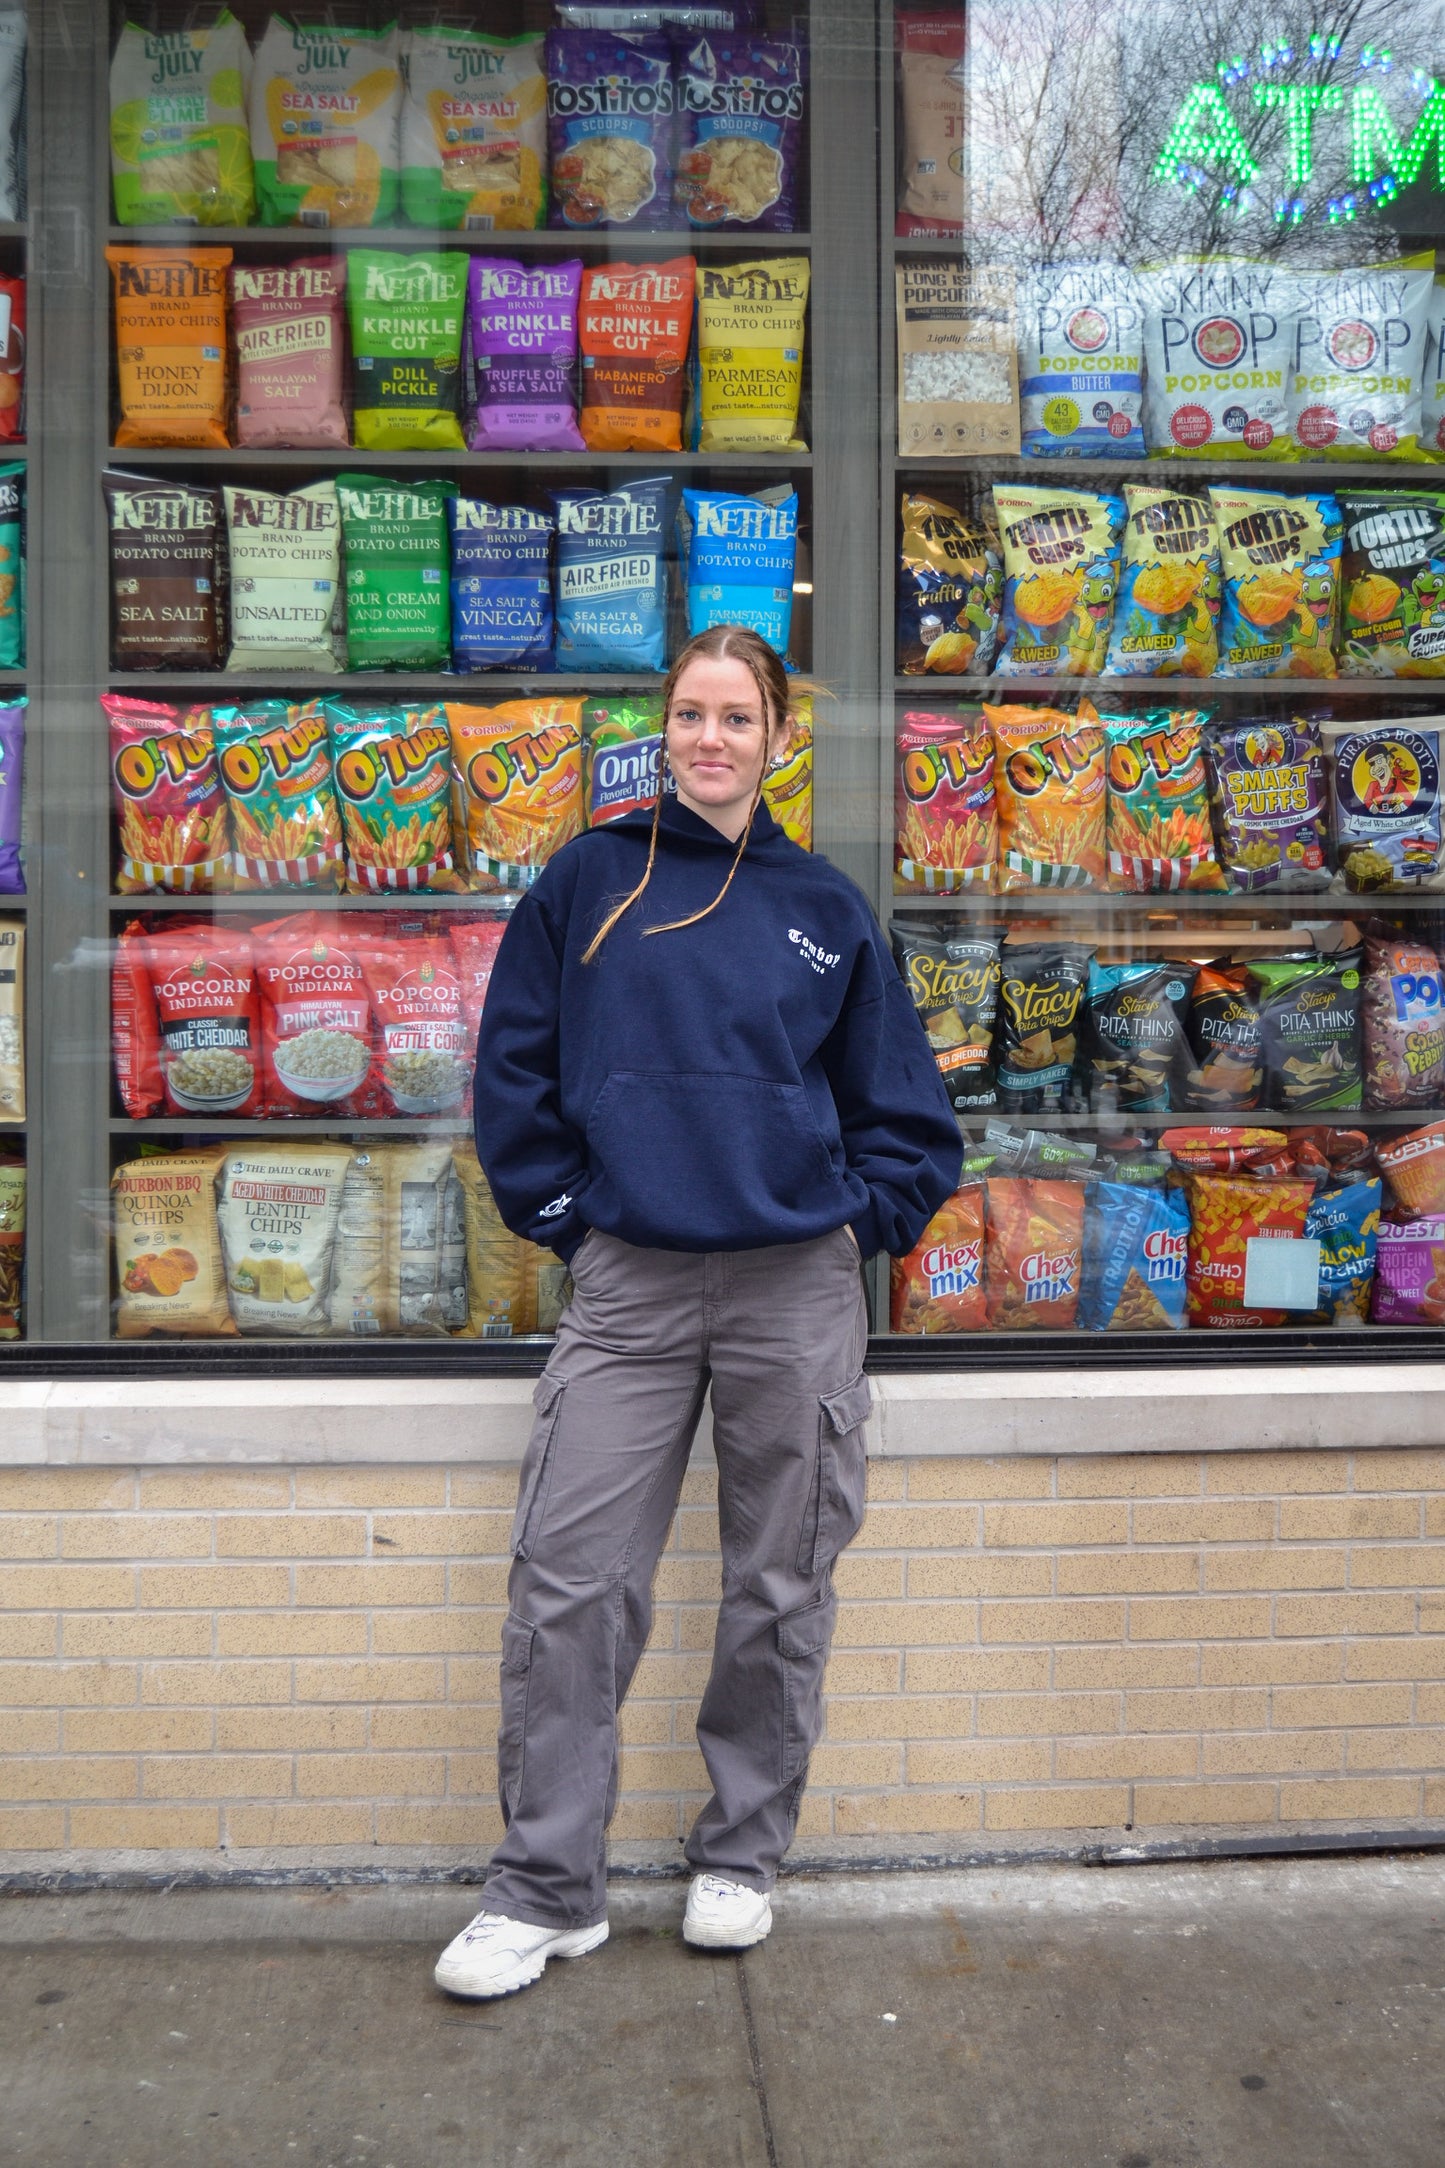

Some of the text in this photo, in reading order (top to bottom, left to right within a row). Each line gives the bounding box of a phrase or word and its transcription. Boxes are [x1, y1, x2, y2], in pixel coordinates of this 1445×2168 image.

[152, 51, 203, 84] JULY
[297, 47, 349, 75] JULY
[455, 54, 505, 84] JULY
[148, 96, 205, 109] SEA SALT
[281, 94, 357, 111] SEA SALT
[442, 102, 516, 116] SEA SALT
[1154, 83, 1445, 184] ATM
[119, 260, 222, 297] KETTLE
[234, 268, 337, 302] KETTLE
[365, 261, 461, 302] KETTLE
[479, 268, 574, 301] KETTLE
[589, 270, 683, 303] KETTLE
[702, 269, 805, 300] KETTLE
[1037, 271, 1132, 302] SKINNY
[1160, 274, 1274, 313] SKINNY
[734, 305, 773, 313] BRAND
[120, 316, 220, 327] POTATO CHIPS
[363, 317, 457, 335] KRINKLE
[481, 315, 572, 332] KRINKLE
[586, 317, 679, 336] KRINKLE
[704, 317, 801, 330] POTATO CHIPS
[1038, 305, 1138, 354] POP
[243, 320, 326, 350] AIR FRIED
[508, 333, 545, 347] CUT
[1162, 313, 1277, 372] POP
[1296, 316, 1411, 372] POP
[136, 366, 204, 380] HONEY
[1039, 357, 1139, 372] POPCORN
[393, 368, 428, 380] DILL
[485, 370, 568, 381] TRUFFLE OIL
[594, 371, 666, 384] HABANERO
[708, 369, 798, 383] PARMESAN
[1165, 371, 1282, 393] POPCORN
[143, 384, 198, 397] DIJON
[382, 383, 438, 395] PICKLE
[613, 385, 645, 395] LIME
[723, 384, 786, 397] GARLIC
[1072, 376, 1111, 390] BUTTER
[1295, 377, 1412, 395] POPCORN
[264, 386, 302, 398] SALT
[1054, 404, 1069, 416] 43
[1248, 432, 1269, 444] FREE
[1374, 435, 1395, 447] FREE
[111, 490, 216, 530] KETTLE
[231, 492, 338, 531] KETTLE
[342, 487, 444, 521] KETTLE
[370, 525, 410, 534] BRAND
[1005, 507, 1093, 549] TURTLE
[1224, 508, 1309, 550] TURTLE
[1349, 510, 1435, 551] TURTLE
[144, 534, 185, 543] BRAND
[262, 533, 302, 543] BRAND
[487, 535, 526, 543] BRAND
[587, 539, 628, 548] BRAND
[727, 542, 766, 551] BRAND
[1153, 528, 1210, 554] CHIPS
[114, 548, 214, 559] POTATO CHIPS
[232, 547, 333, 560] POTATO CHIPS
[1027, 537, 1086, 565] CHIPS
[1247, 536, 1300, 566] CHIPS
[1368, 539, 1426, 568] CHIPS
[698, 556, 794, 569] POTATO CHIPS
[563, 559, 650, 587] AIR FRIED
[913, 584, 962, 608] Truffle
[120, 607, 208, 621] SEA SALT
[235, 606, 327, 622] UNSALTED
[355, 609, 426, 619] AND ONION
[710, 609, 781, 621] FARMSTAND
[570, 623, 643, 635] VINEGAR
[1352, 620, 1402, 639] Sour Cream
[1121, 634, 1175, 653] SEAWEED
[1011, 646, 1060, 663] SEAWEED
[1230, 644, 1283, 664] SEAWEED
[347, 724, 385, 733] ORION
[473, 723, 512, 736] ORION
[1006, 724, 1047, 735] ORION
[1227, 765, 1311, 795] SMART
[1234, 788, 1308, 816] PUFFS
[1280, 816, 1304, 825] CHEDDAR
[1354, 817, 1422, 828] Aged White Cheddar
[788, 929, 840, 968] Tomboy
[154, 979, 252, 999] POPCORN
[288, 981, 353, 994] INDIANA
[169, 996, 234, 1010] INDIANA
[300, 1001, 342, 1010] HIMALAYAN
[925, 991, 974, 1008] Pita Chips
[188, 1020, 219, 1029] CLASSIC
[283, 1010, 361, 1031] PINK SALT
[1017, 1015, 1064, 1032] Pita Chips
[1100, 1016, 1174, 1037] PITA THINS
[1201, 1018, 1233, 1040] PITA
[1280, 1010, 1355, 1031] PITA THINS
[1407, 1029, 1444, 1051] COCOA
[1007, 1067, 1067, 1086] SIMPLY NAKED
[1042, 1147, 1065, 1162] 60%
[1120, 1165, 1141, 1178] 60%
[123, 1194, 192, 1211] QUINOA
[233, 1183, 325, 1205] AGED WHITE CHEDDAR
[132, 1211, 184, 1226] CHIPS
[245, 1201, 311, 1220] LENTIL
[250, 1218, 303, 1235] CHIPS
[1377, 1223, 1439, 1239] QUEST
[923, 1239, 981, 1277] Chex
[1020, 1248, 1079, 1282] Chex
[1194, 1260, 1242, 1278] CHIPS
[930, 1260, 979, 1299] mix
[1025, 1271, 1074, 1303] mix
[1397, 1289, 1420, 1298] SWEET
[1210, 1315, 1263, 1327] Garcia
